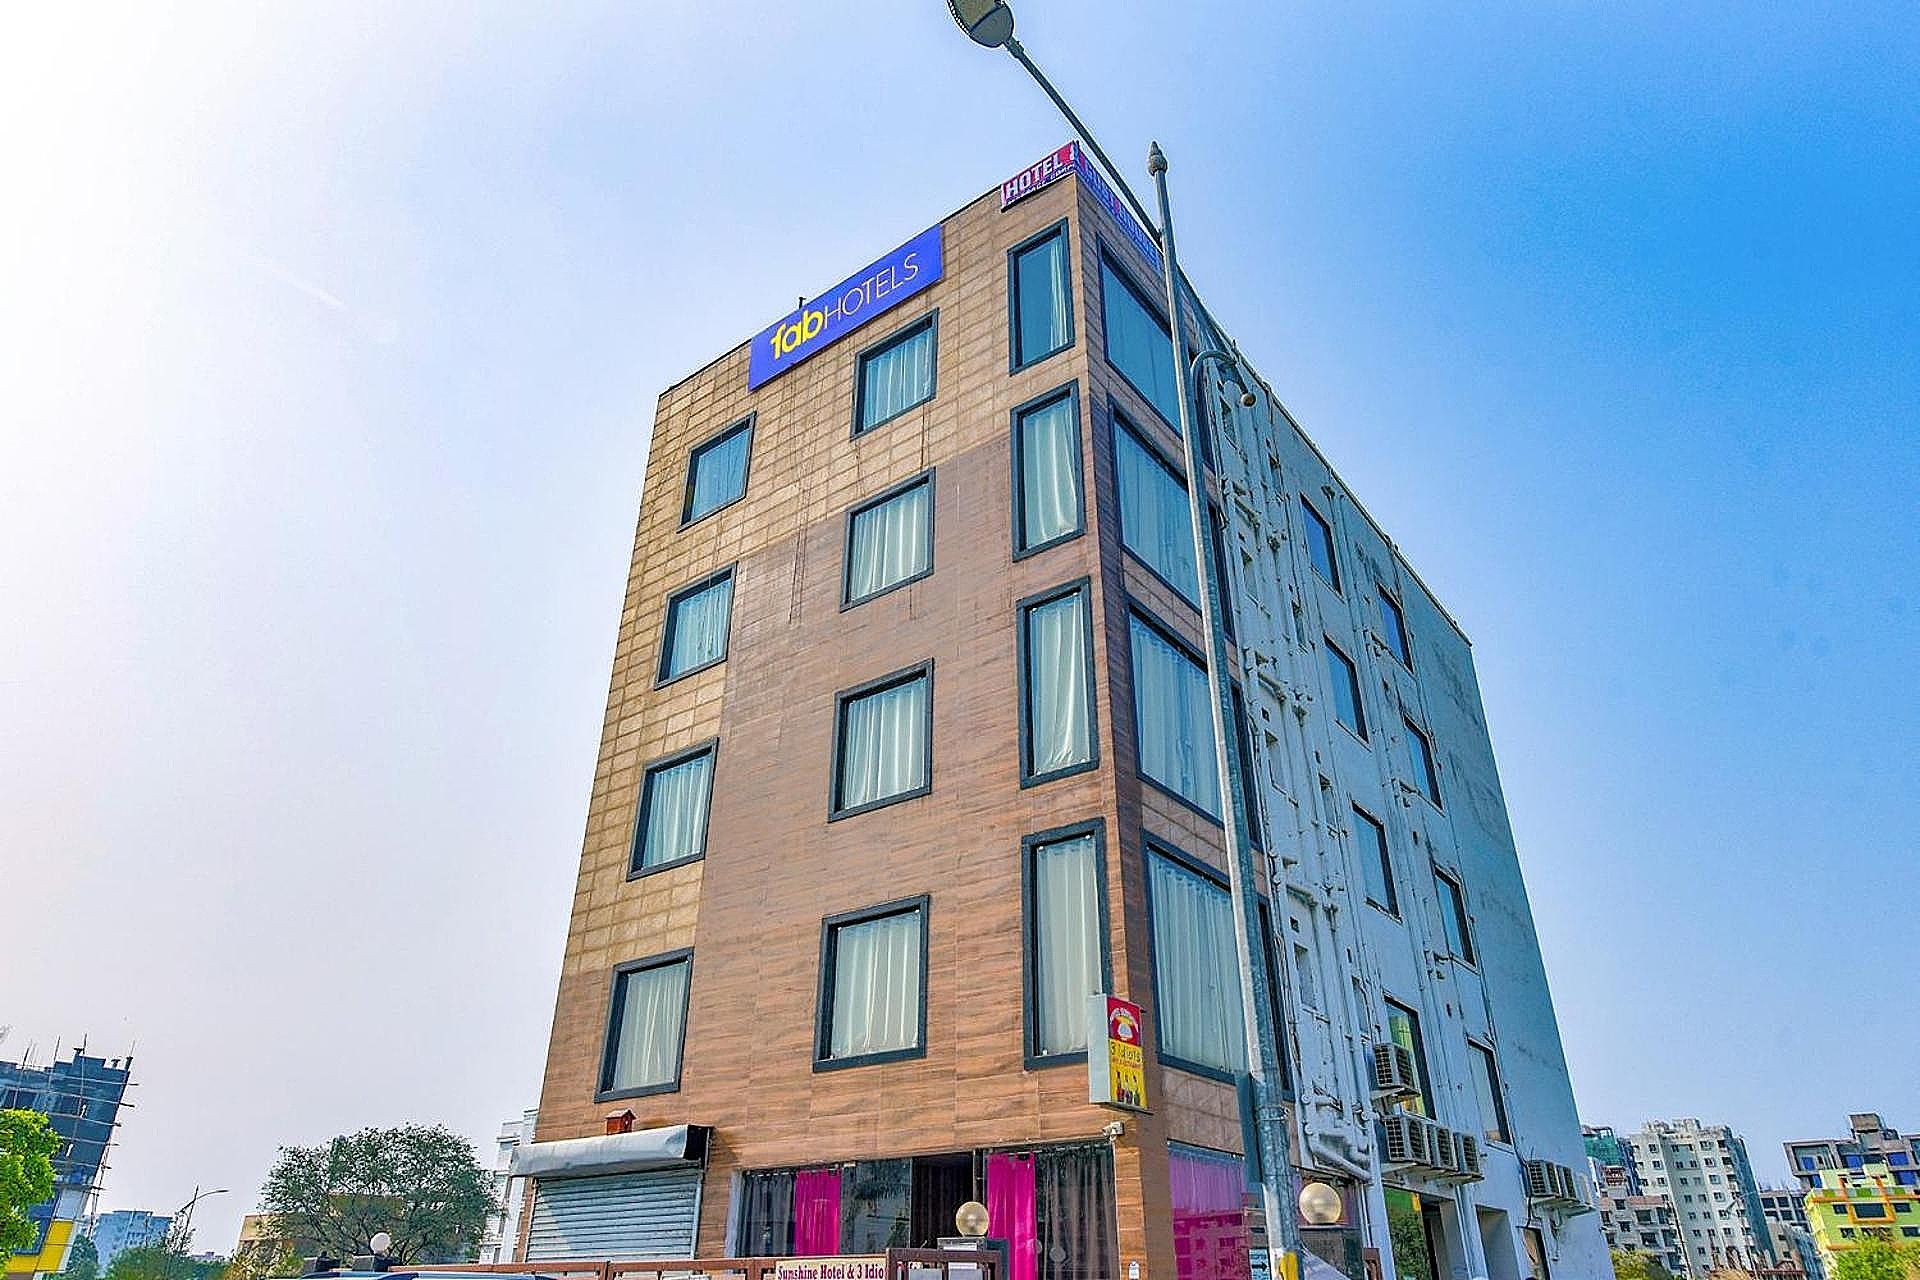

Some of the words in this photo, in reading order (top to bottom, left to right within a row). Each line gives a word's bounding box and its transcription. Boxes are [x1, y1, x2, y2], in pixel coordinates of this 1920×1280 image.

[1005, 153, 1063, 200] HOTEL
[778, 1265, 818, 1280] Sunshine
[821, 1264, 845, 1279] Hotel
[847, 1264, 855, 1279] &
[857, 1264, 863, 1279] 3
[865, 1264, 885, 1279] Idio
